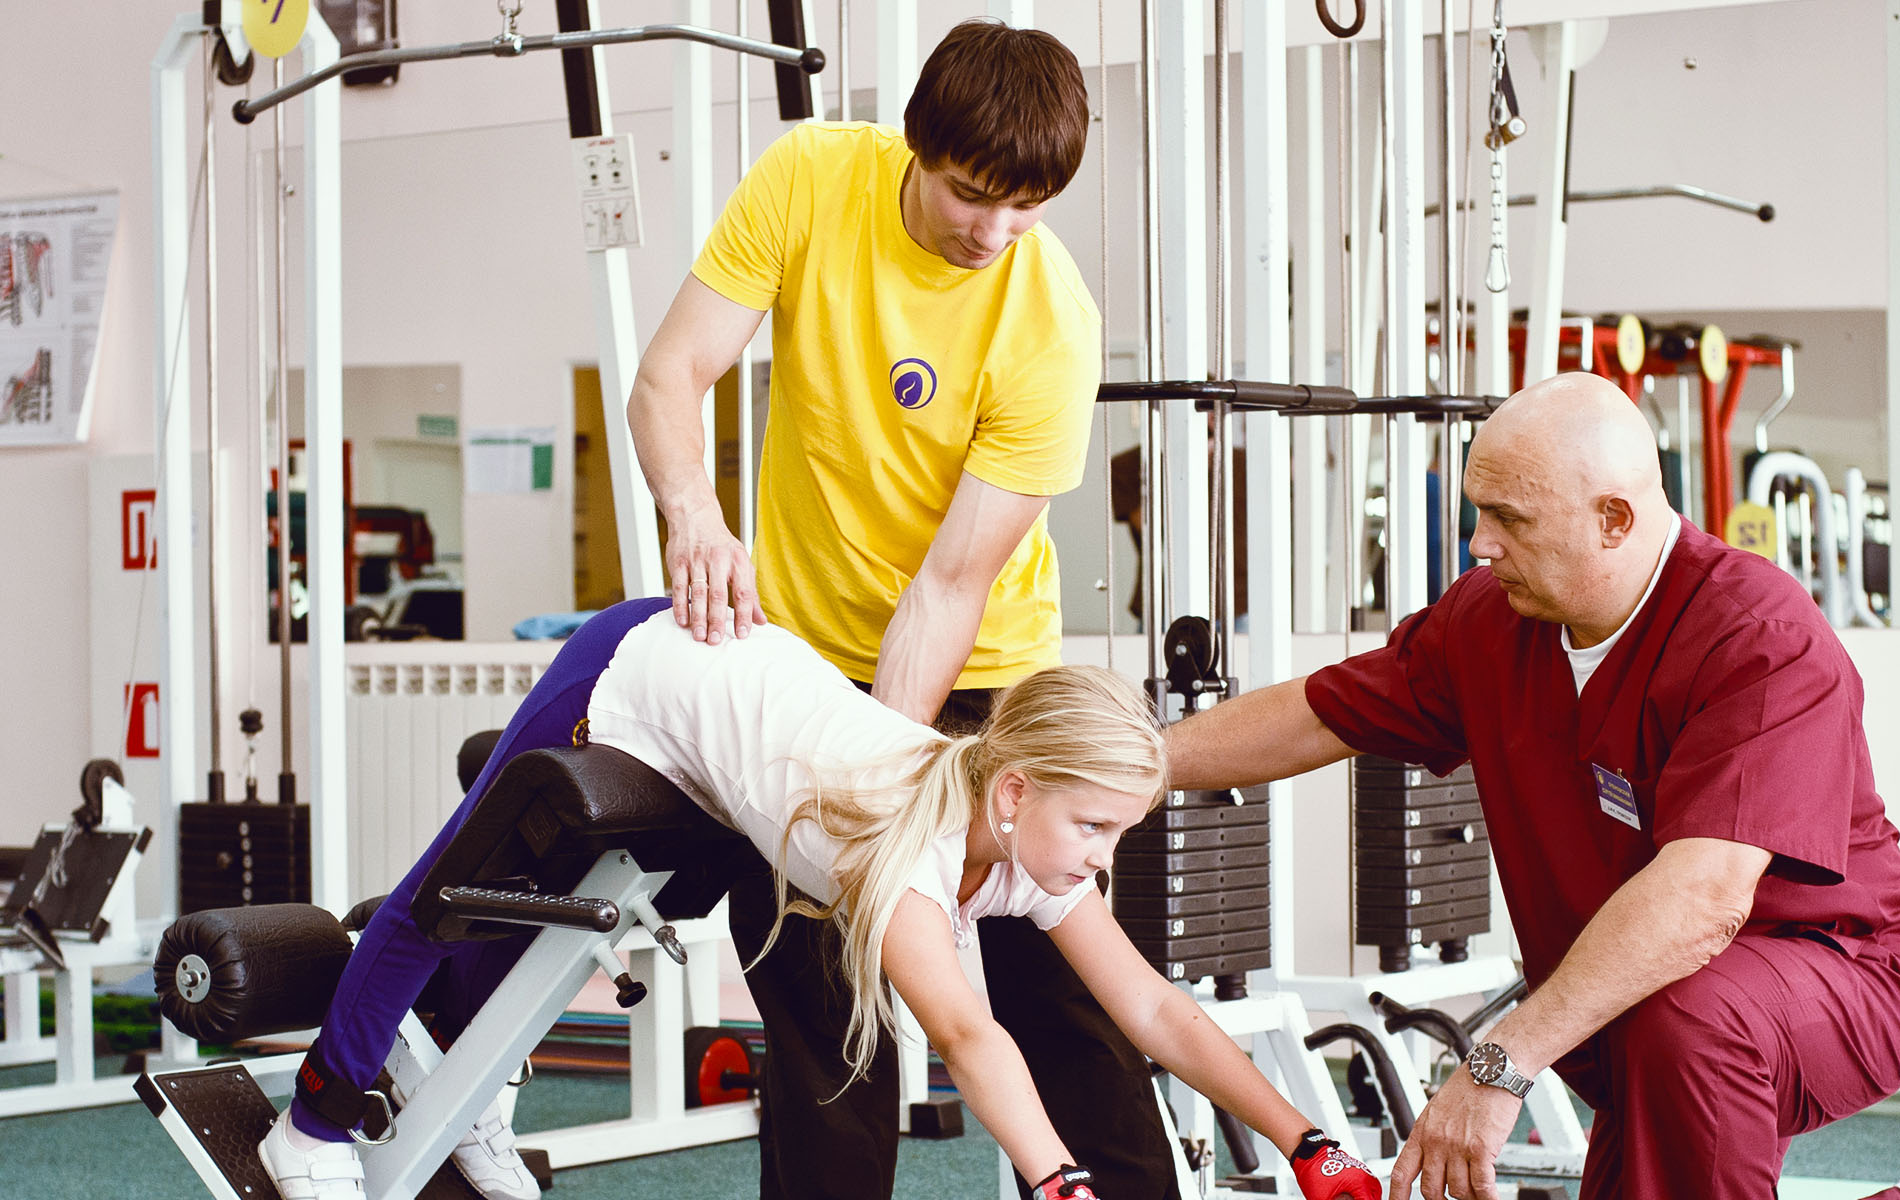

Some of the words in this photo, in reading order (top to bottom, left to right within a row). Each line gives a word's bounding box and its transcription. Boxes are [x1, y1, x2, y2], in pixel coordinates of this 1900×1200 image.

[1173, 789, 1185, 806] 20
[1173, 833, 1185, 849] 30
[1173, 877, 1184, 893] 40
[1172, 919, 1185, 937] 50
[1172, 963, 1185, 979] 60
